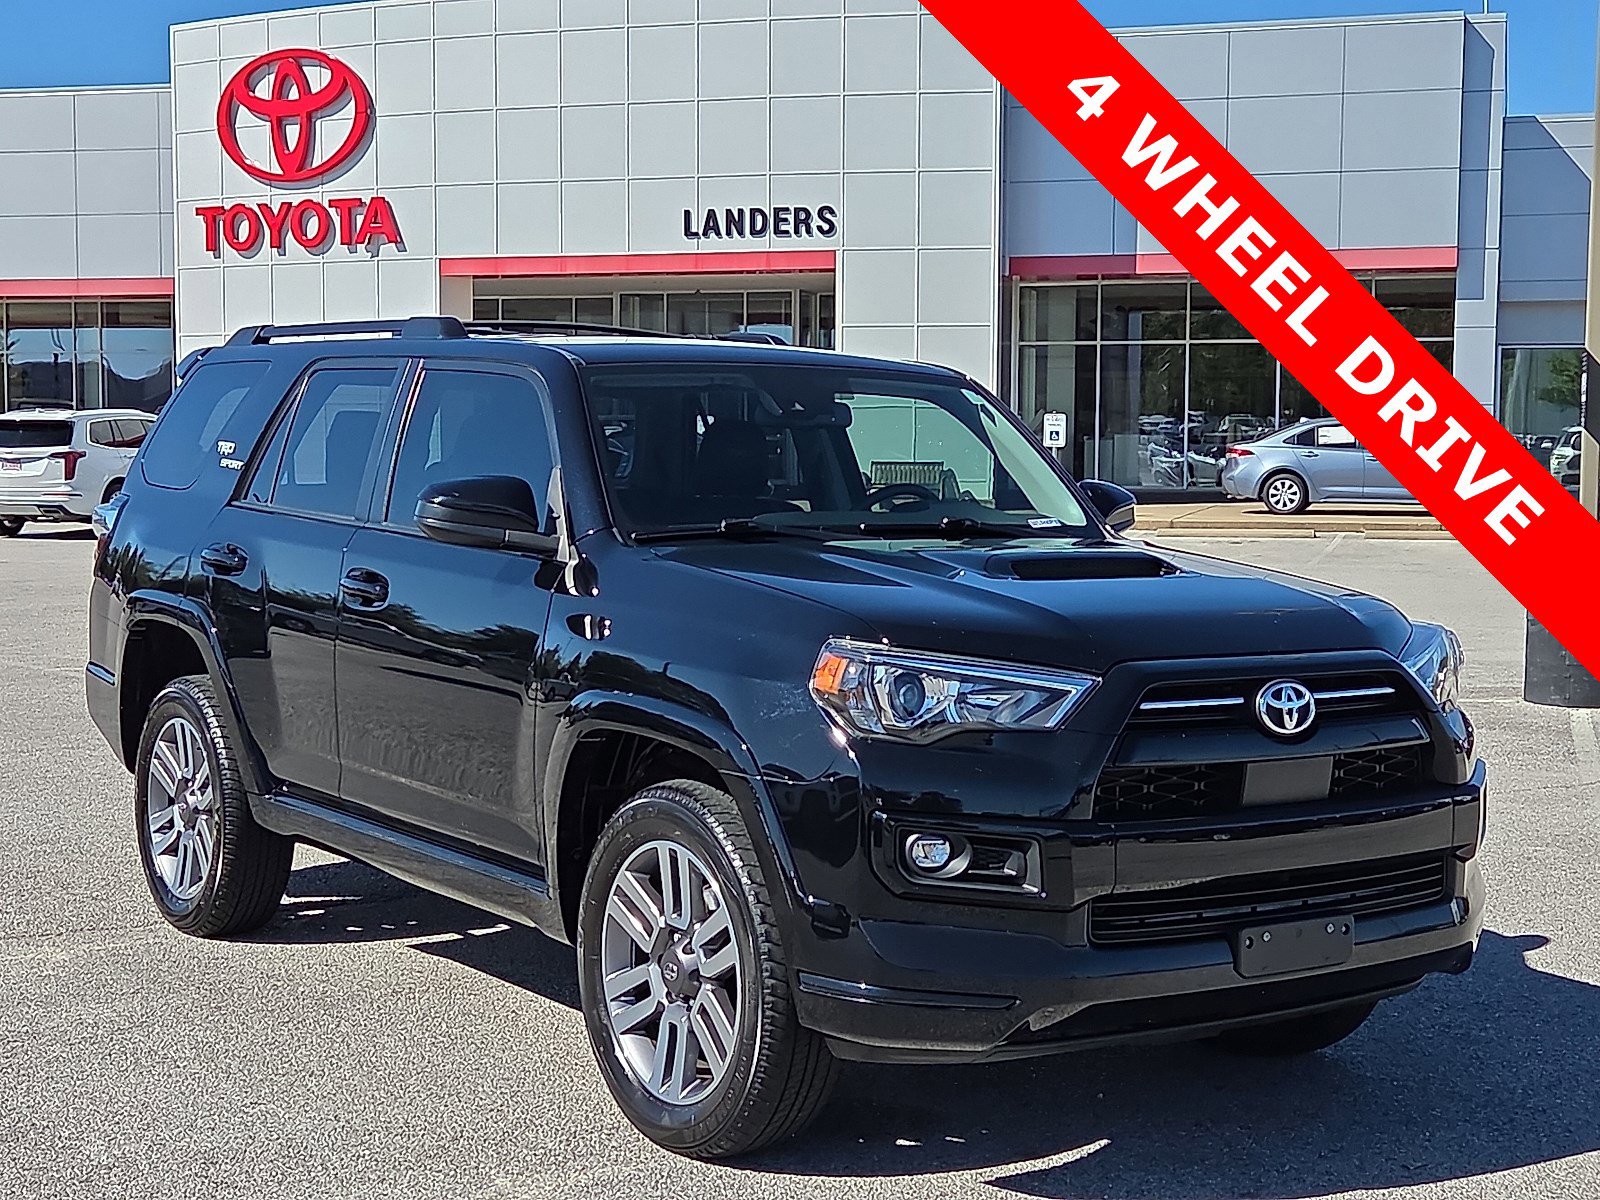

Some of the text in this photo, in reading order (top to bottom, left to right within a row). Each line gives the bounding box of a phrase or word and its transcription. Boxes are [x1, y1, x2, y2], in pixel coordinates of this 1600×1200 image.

[196, 197, 401, 254] TOYOTA
[684, 206, 837, 238] LANDERS
[217, 440, 236, 455] TRD
[220, 458, 244, 470] SPORT
